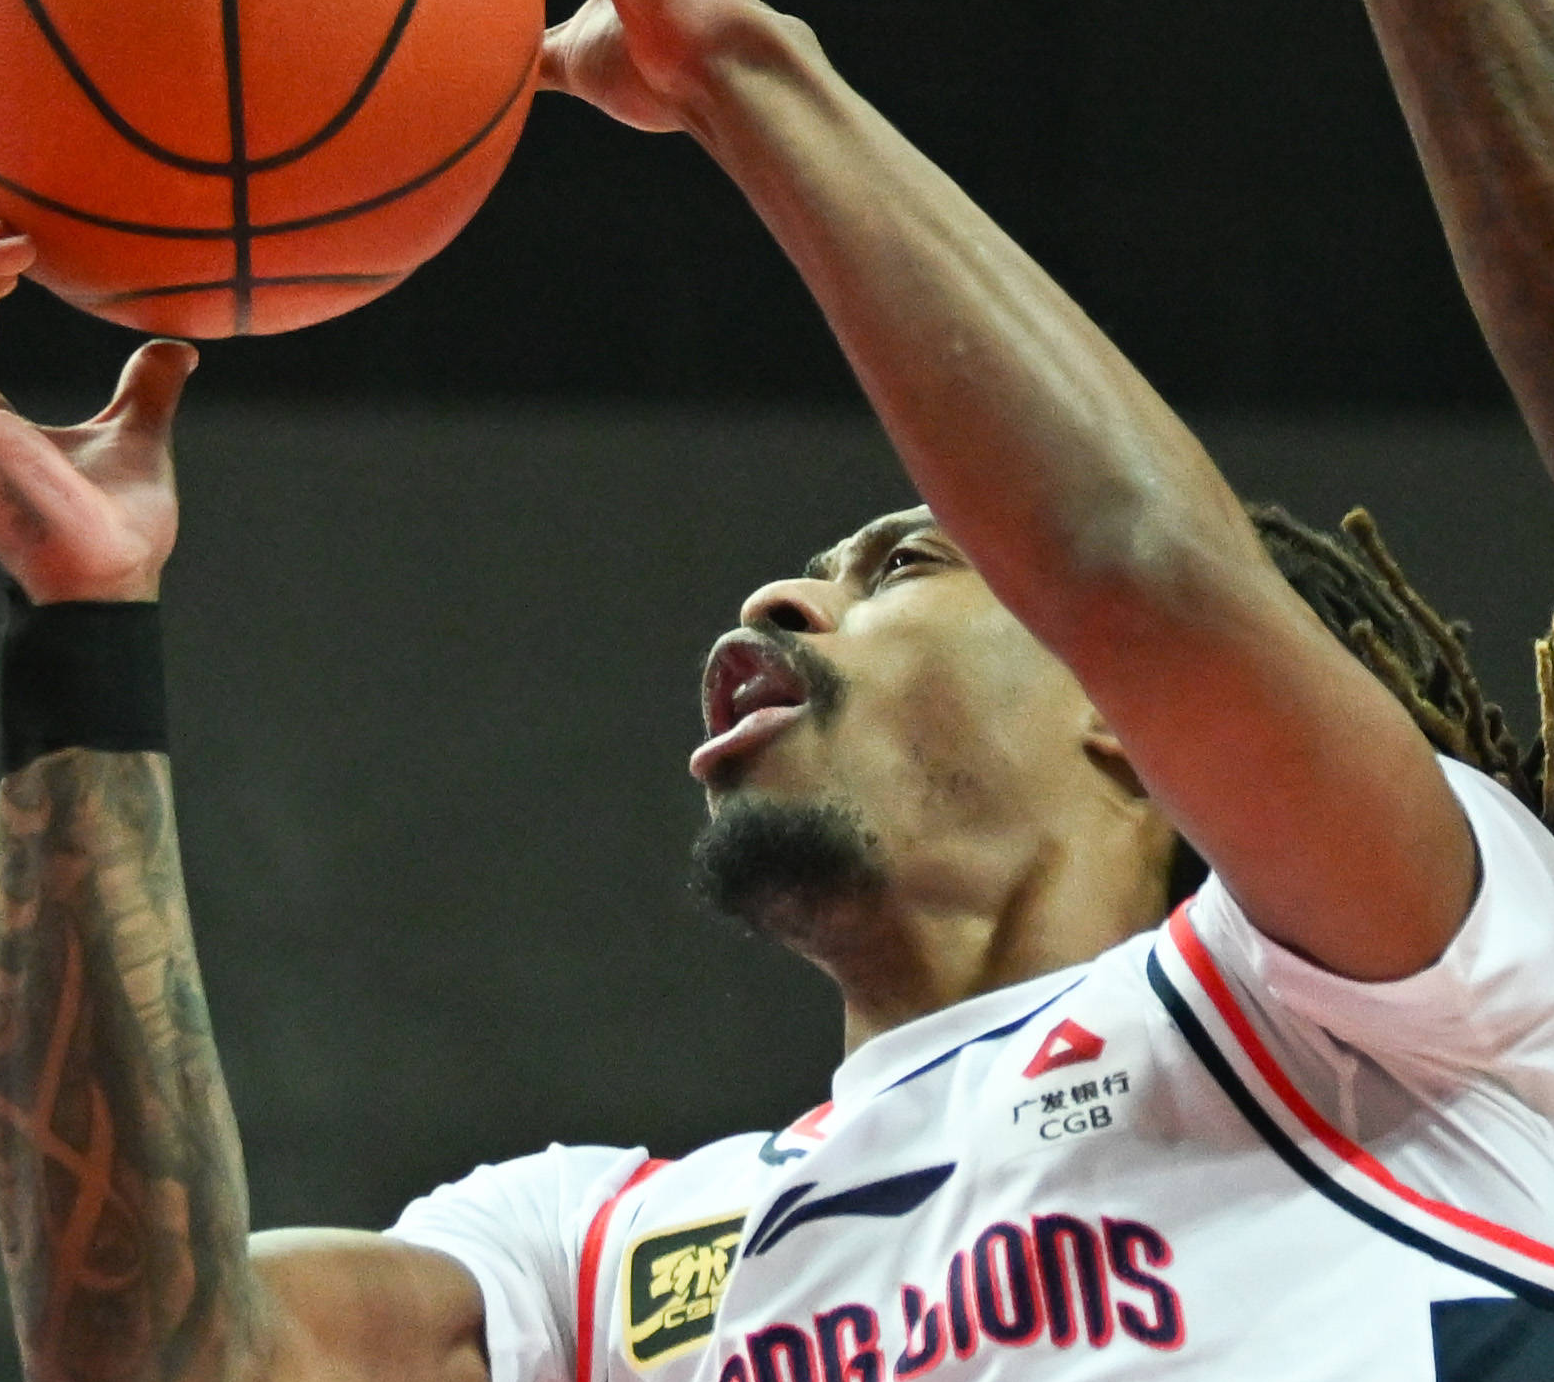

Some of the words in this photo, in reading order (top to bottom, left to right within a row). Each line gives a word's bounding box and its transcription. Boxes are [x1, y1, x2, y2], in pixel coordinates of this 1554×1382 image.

[1013, 1071, 1130, 1125] 广发银行
[1039, 1105, 1113, 1140] CGB
